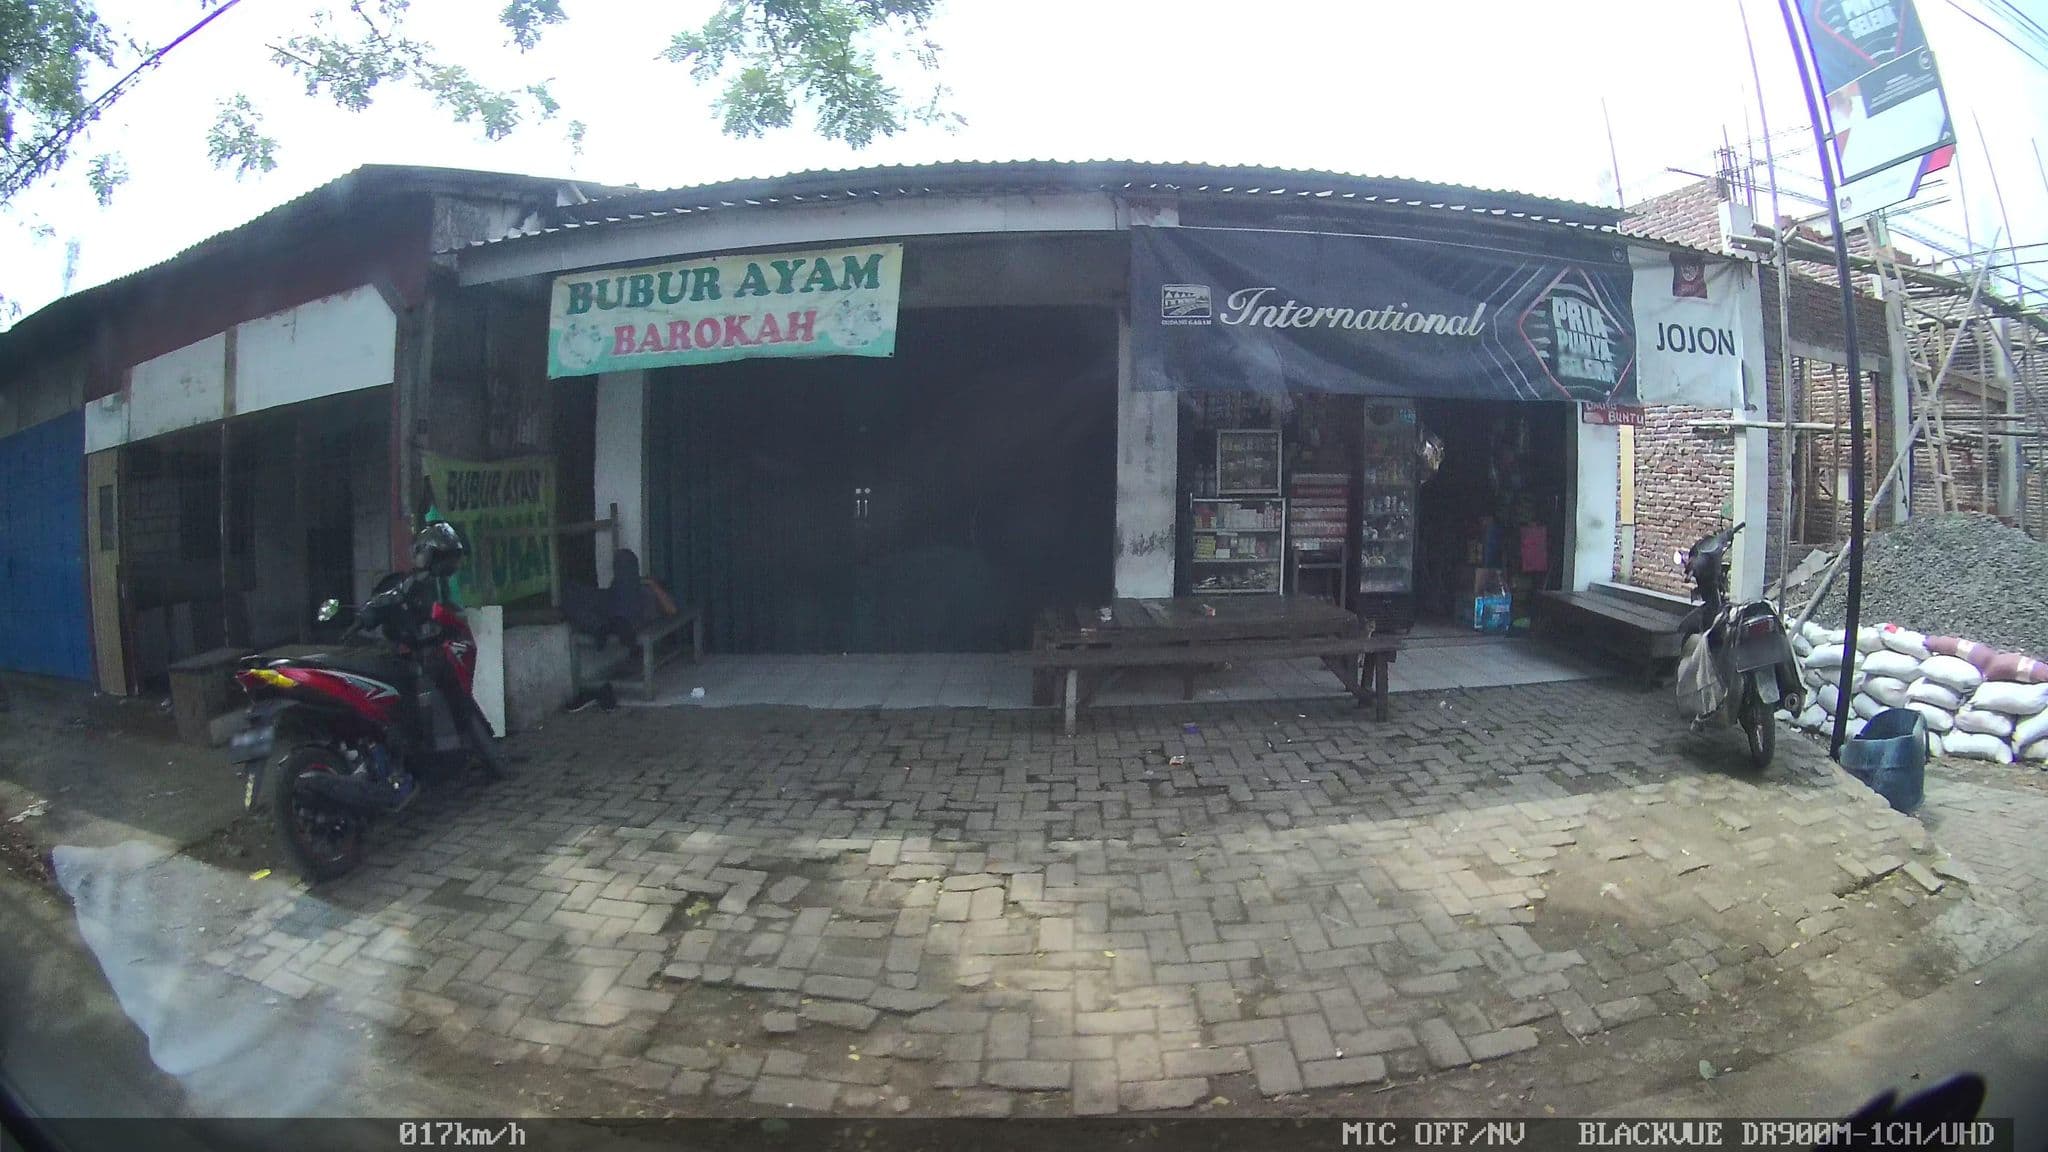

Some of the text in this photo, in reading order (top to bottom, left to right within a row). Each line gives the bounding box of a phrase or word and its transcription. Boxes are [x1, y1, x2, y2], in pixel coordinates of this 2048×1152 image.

[567, 253, 884, 315] BUBUR AYAM
[1220, 286, 1487, 337] International
[1552, 296, 1609, 339] PRIA
[610, 310, 818, 356] BAROKAH
[1556, 328, 1614, 361] PUNYA
[1656, 322, 1736, 356] JOJON
[1608, 410, 1644, 425] BUNTU
[447, 470, 500, 512] BUBUR
